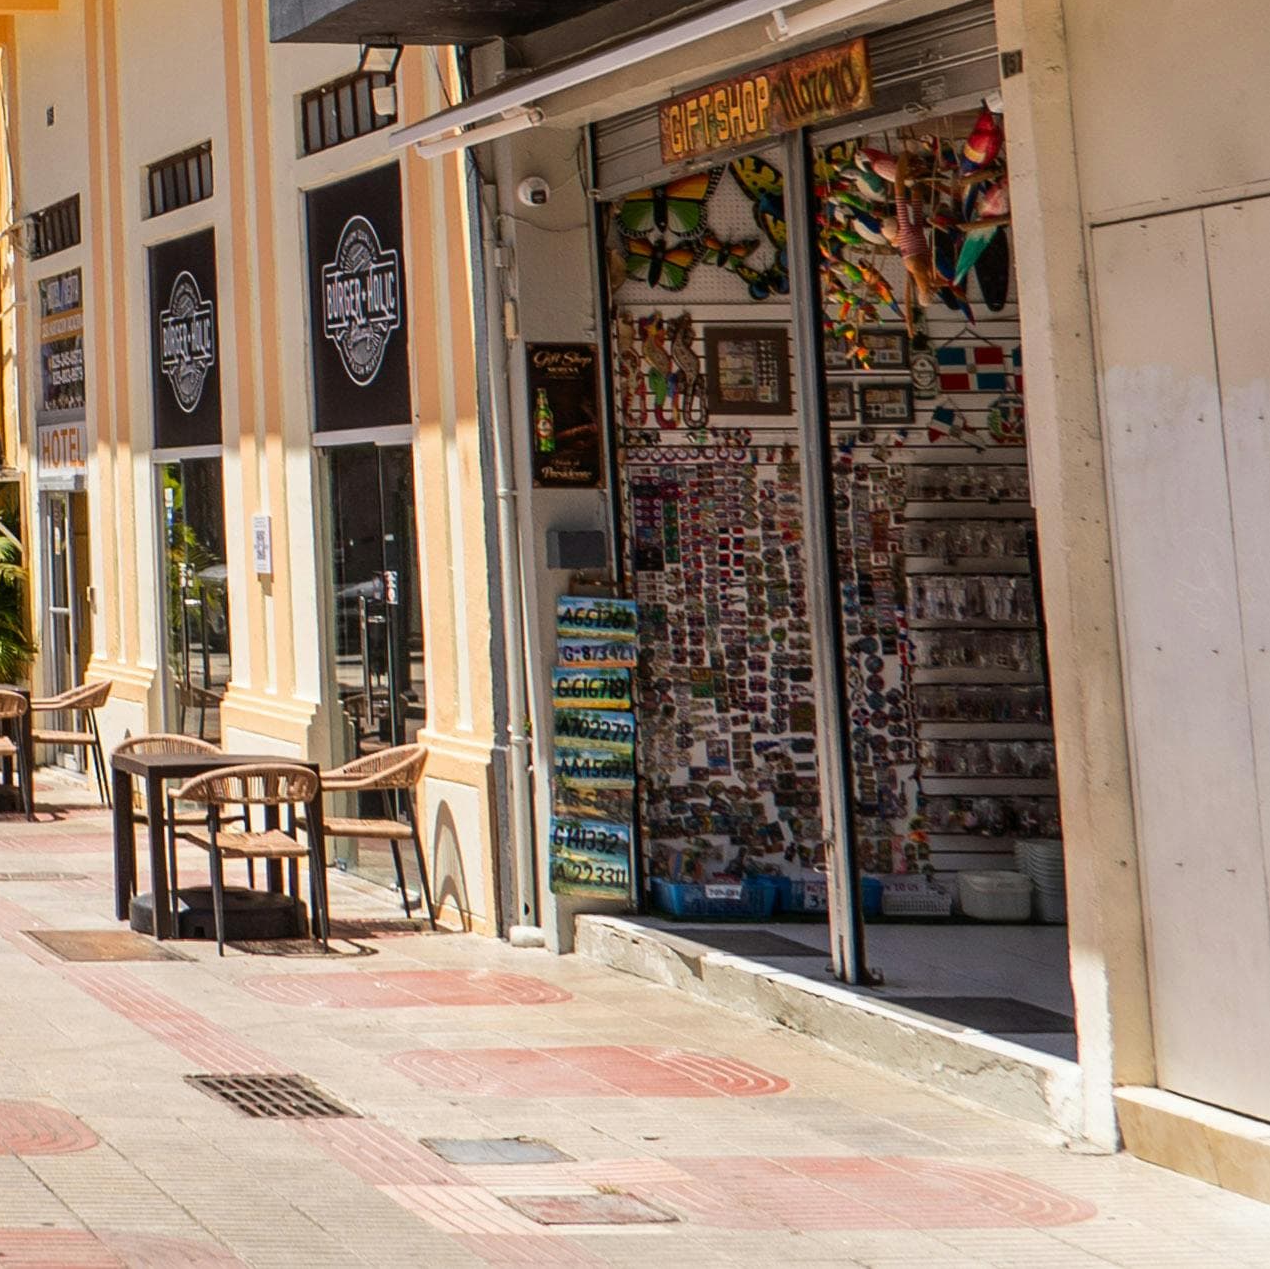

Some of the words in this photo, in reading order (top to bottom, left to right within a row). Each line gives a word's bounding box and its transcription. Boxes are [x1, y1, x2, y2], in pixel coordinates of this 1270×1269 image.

[668, 93, 711, 156] GIFT
[713, 75, 770, 142] SHOP
[42, 427, 86, 469] HOTEL
